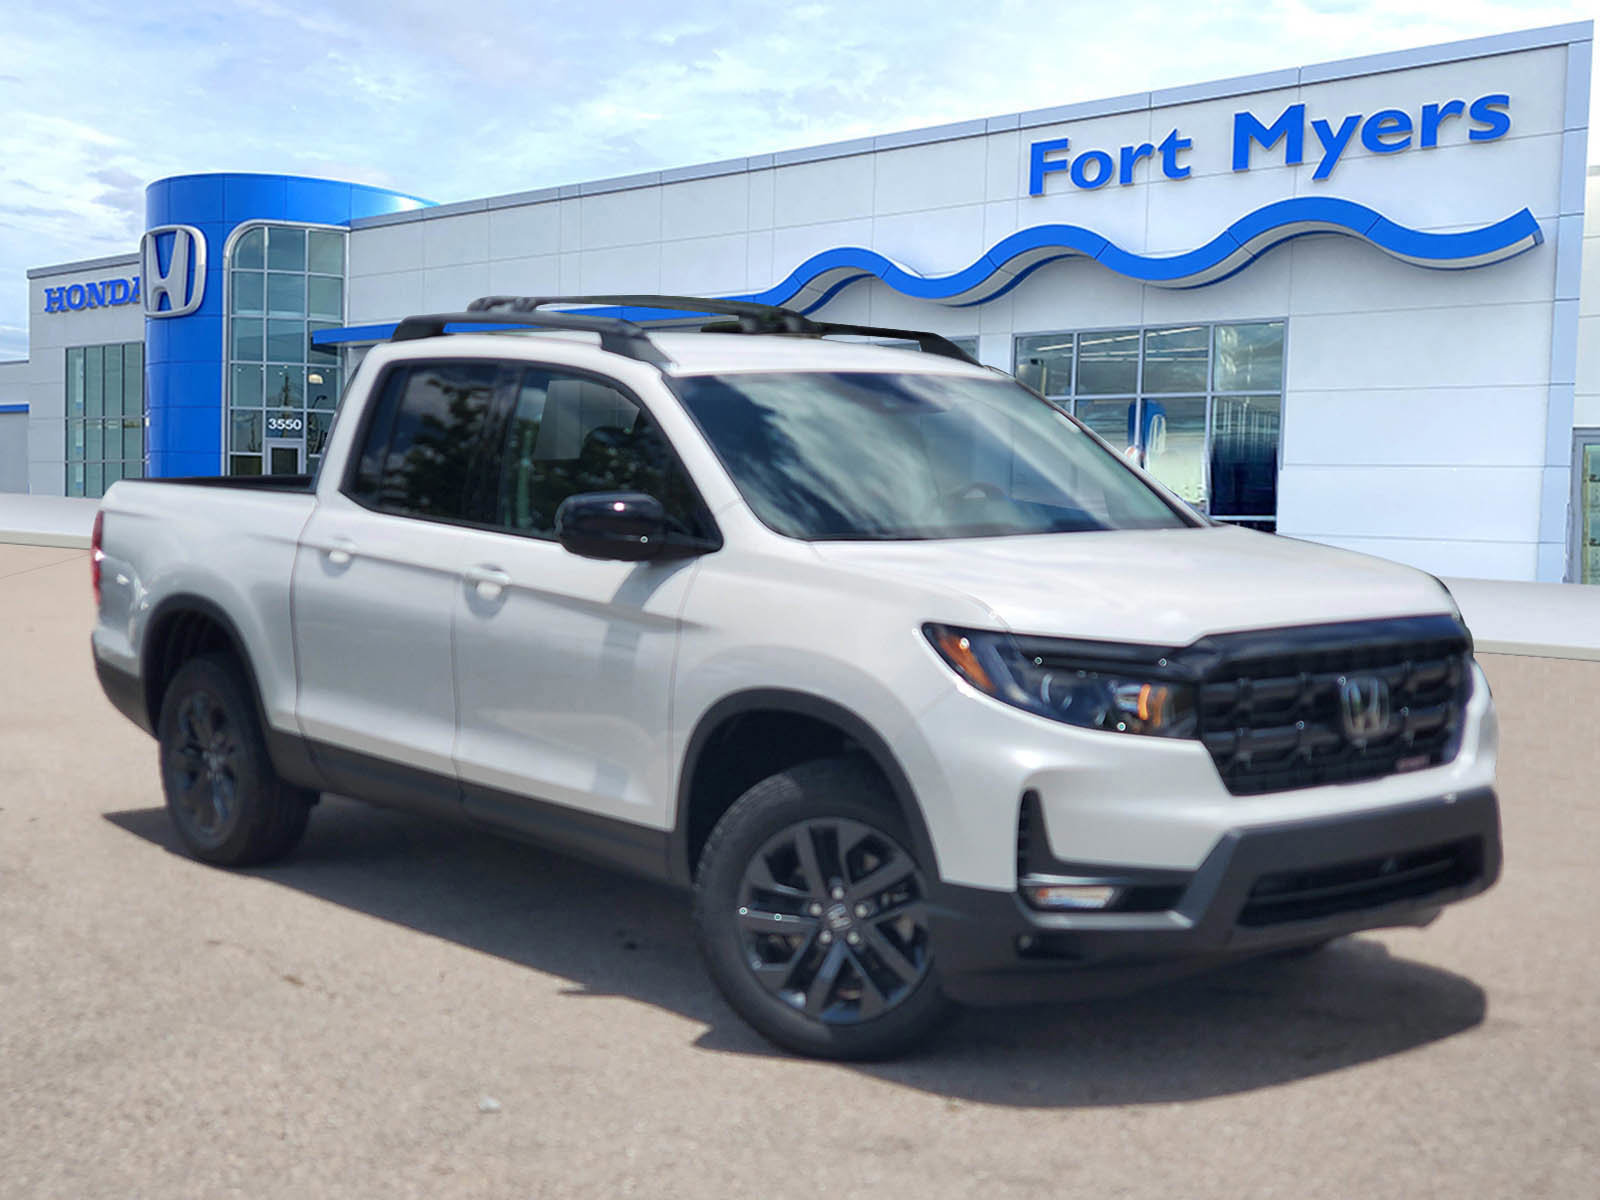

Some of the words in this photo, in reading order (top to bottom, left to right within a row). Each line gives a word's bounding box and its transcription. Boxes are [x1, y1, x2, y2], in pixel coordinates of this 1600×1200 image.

[1029, 129, 1192, 196] Fort
[1232, 94, 1511, 180] Myers
[268, 418, 302, 430] 3550
